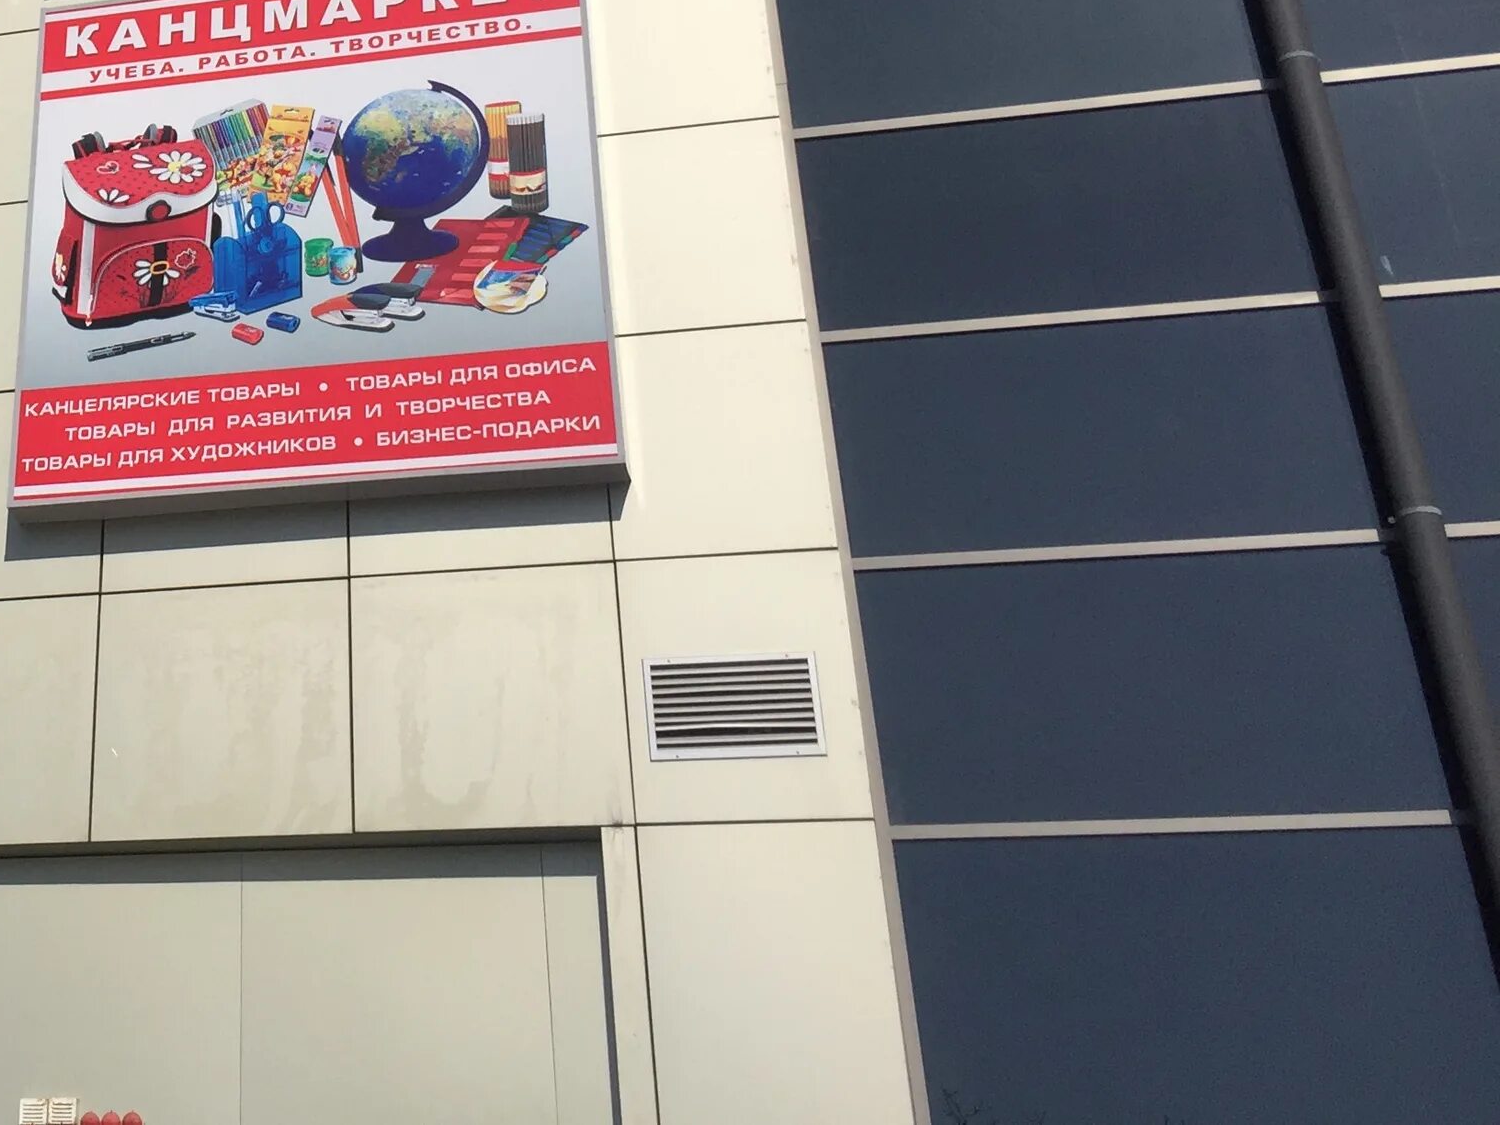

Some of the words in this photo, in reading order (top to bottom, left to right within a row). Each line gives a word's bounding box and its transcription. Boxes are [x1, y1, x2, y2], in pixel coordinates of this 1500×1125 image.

[88, 60, 185, 84] УЧЕБА.
[198, 43, 317, 72] РАБОТА.
[330, 17, 533, 55] ТВОРЧЕСТВО.
[24, 389, 200, 417] КАНЦЕЛЯРСКИЕ
[206, 381, 301, 401] ТОВАРЫ
[346, 371, 442, 391] ТОВАРЫ
[449, 365, 498, 384] ДЛЯ
[504, 356, 596, 379] ОФИСА
[65, 421, 156, 440] ТОВАРЫ
[167, 416, 214, 436] ДЛЯ
[226, 405, 351, 429] РАЗВИТИЯ
[365, 402, 382, 419] И
[396, 389, 551, 415] ТВОРЧЕСТВА
[22, 452, 111, 473] ТОВАРЫ
[117, 446, 163, 467] ДЛЯ
[171, 434, 336, 463] ХУДОЖНИКОВ
[376, 415, 601, 447] БИЗНЕС-ПОДАРКИ
